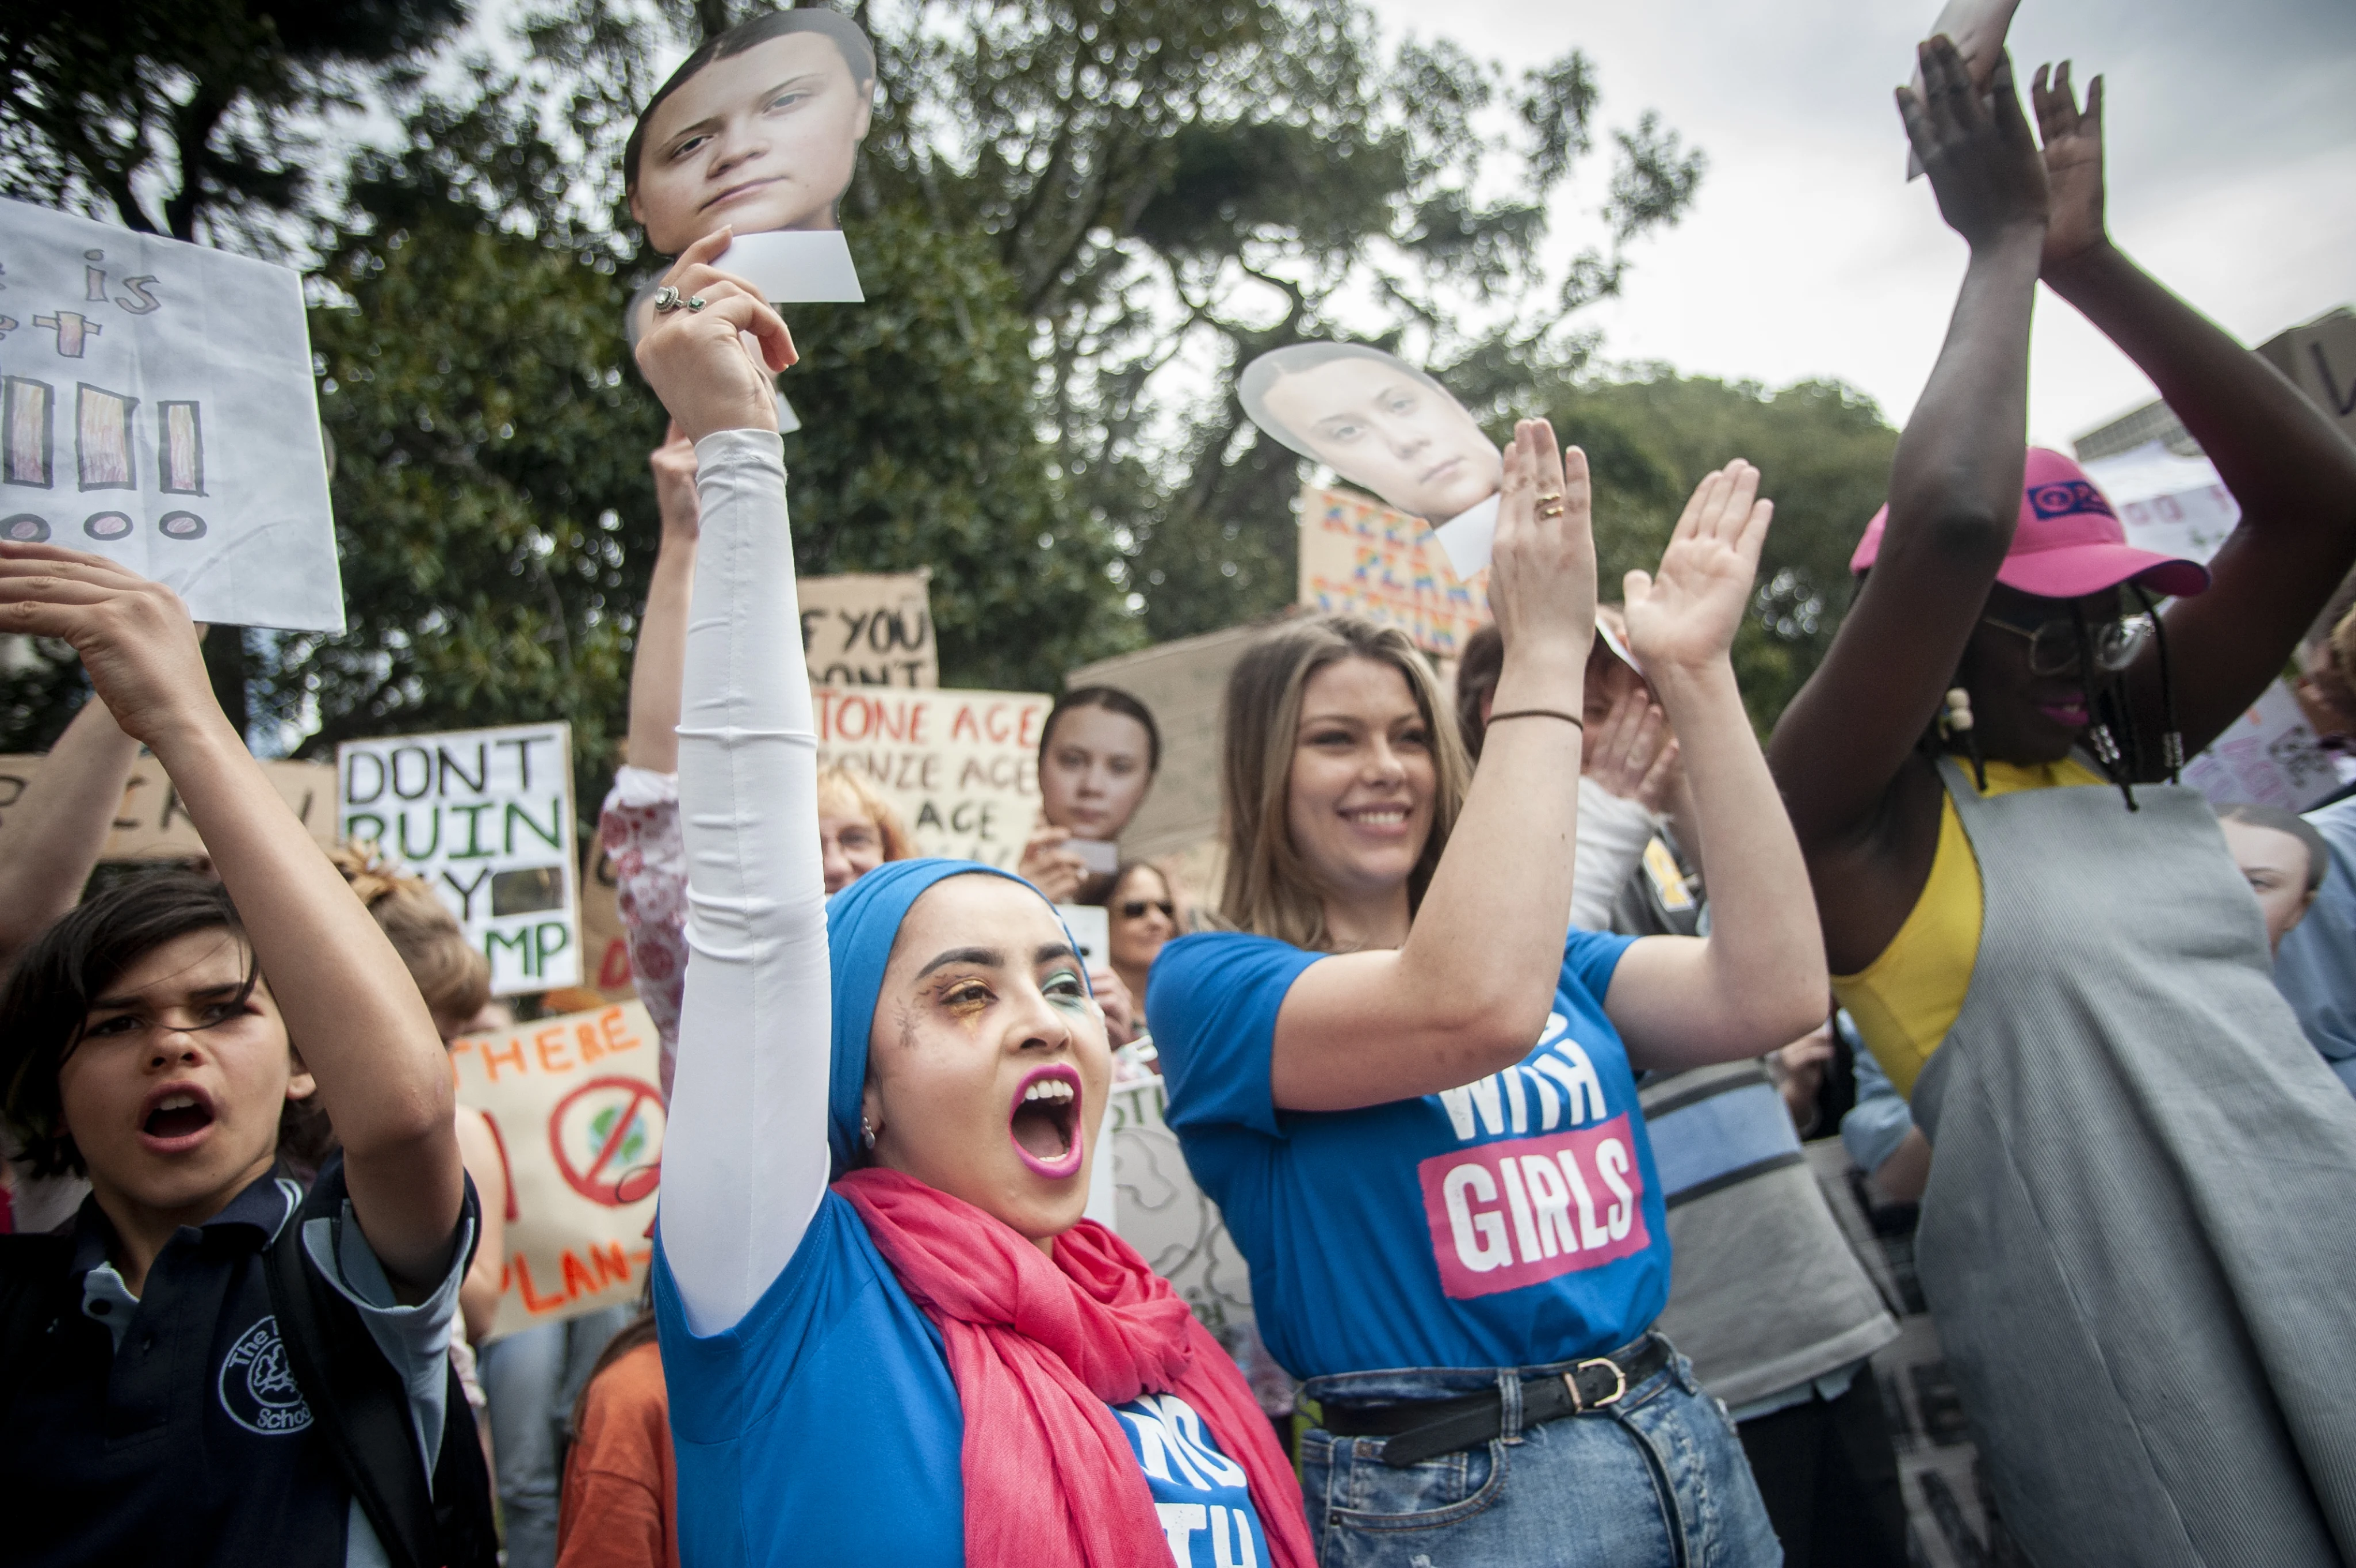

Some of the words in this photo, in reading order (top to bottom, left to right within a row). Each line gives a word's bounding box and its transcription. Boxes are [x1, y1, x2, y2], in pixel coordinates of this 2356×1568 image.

[84, 248, 160, 315] is
[839, 606, 924, 654] YOU
[813, 692, 930, 743] TONE
[952, 699, 1040, 749] AGE
[347, 734, 554, 805] DONT
[484, 921, 569, 978] MP
[1443, 1138, 1634, 1273] GIRLS
[228, 1330, 269, 1368] The
